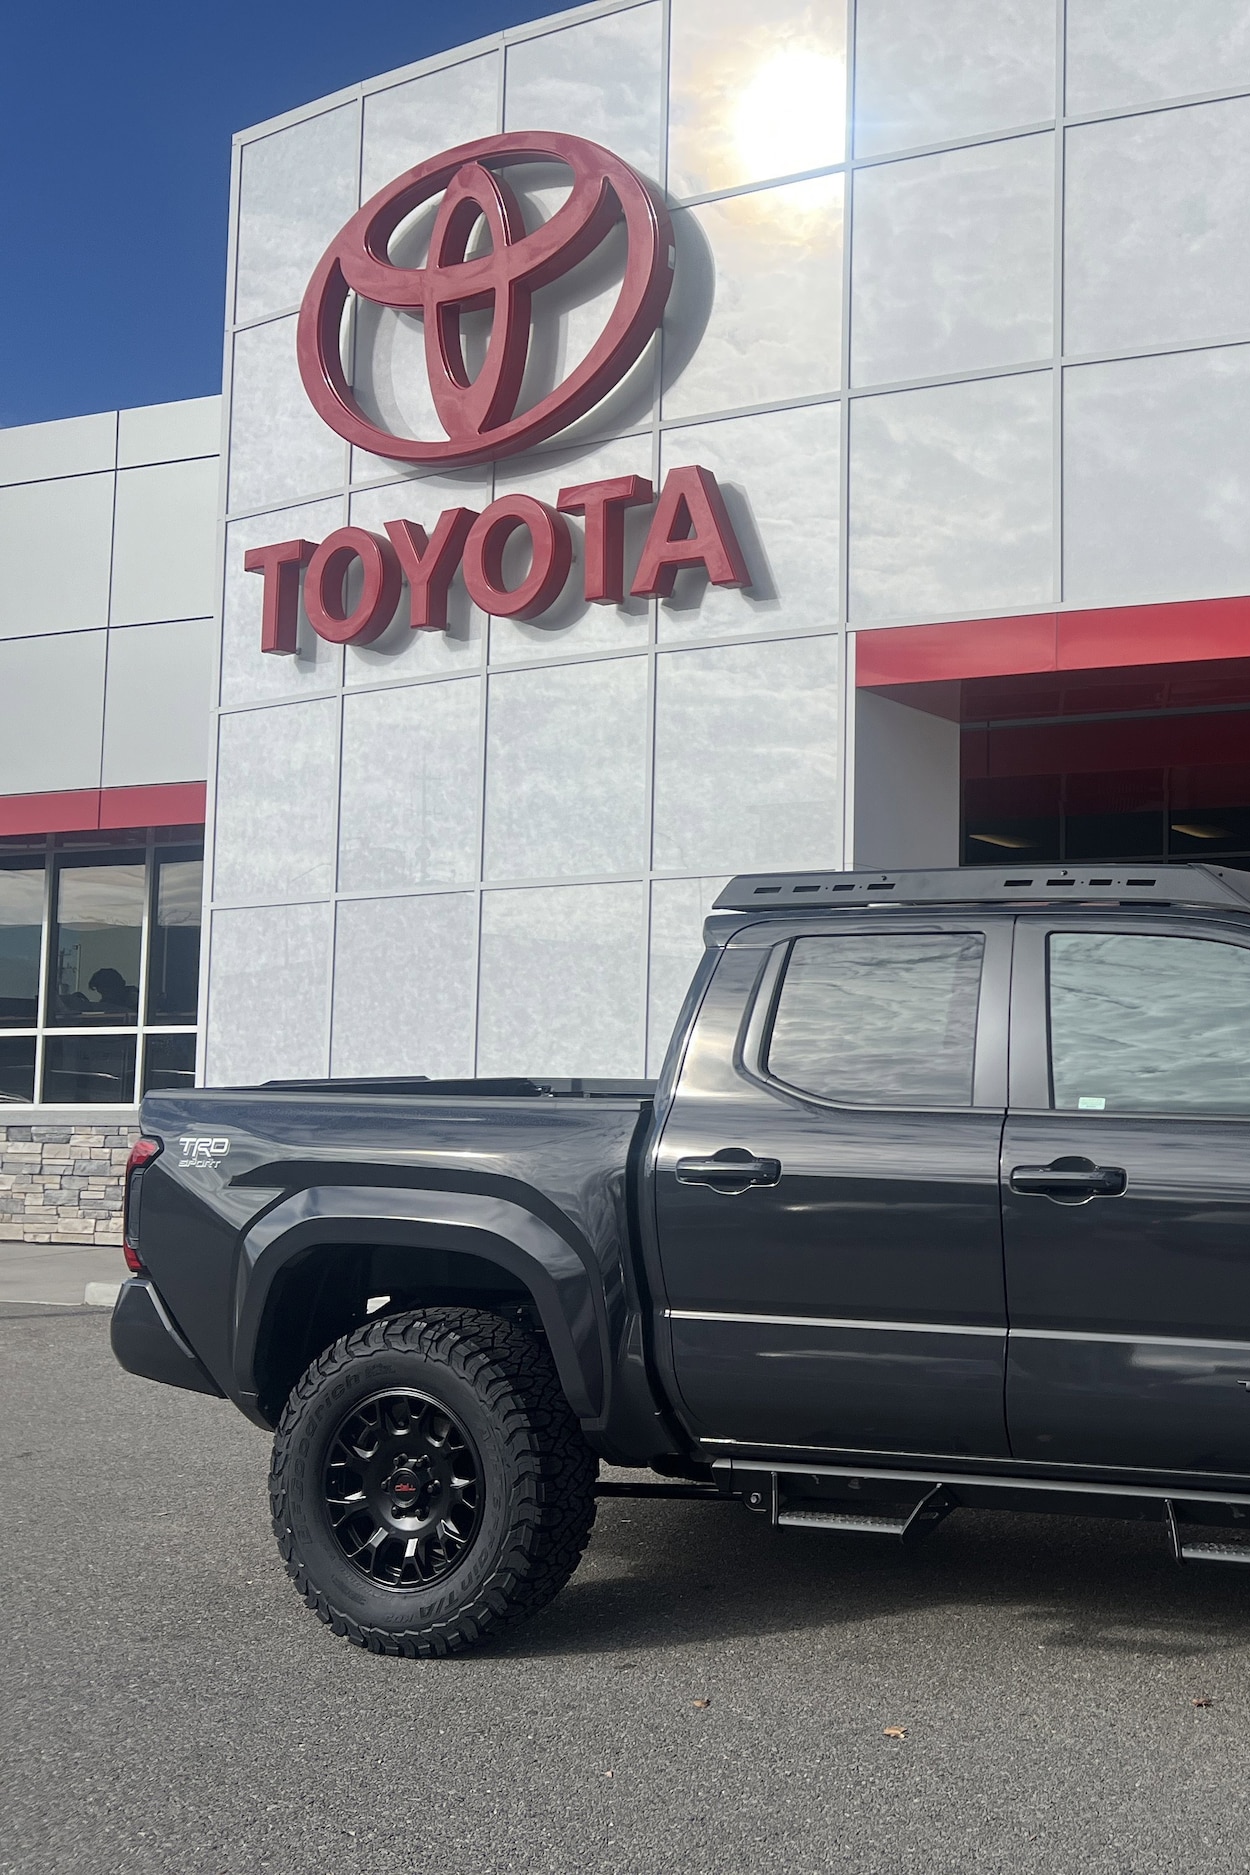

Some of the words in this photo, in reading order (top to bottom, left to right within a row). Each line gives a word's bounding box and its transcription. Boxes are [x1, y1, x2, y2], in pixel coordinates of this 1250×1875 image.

[244, 464, 752, 656] TOYOTA
[177, 1157, 222, 1170] SPORT
[178, 1137, 231, 1158] TRD
[291, 1373, 361, 1545] BFGoodrich
